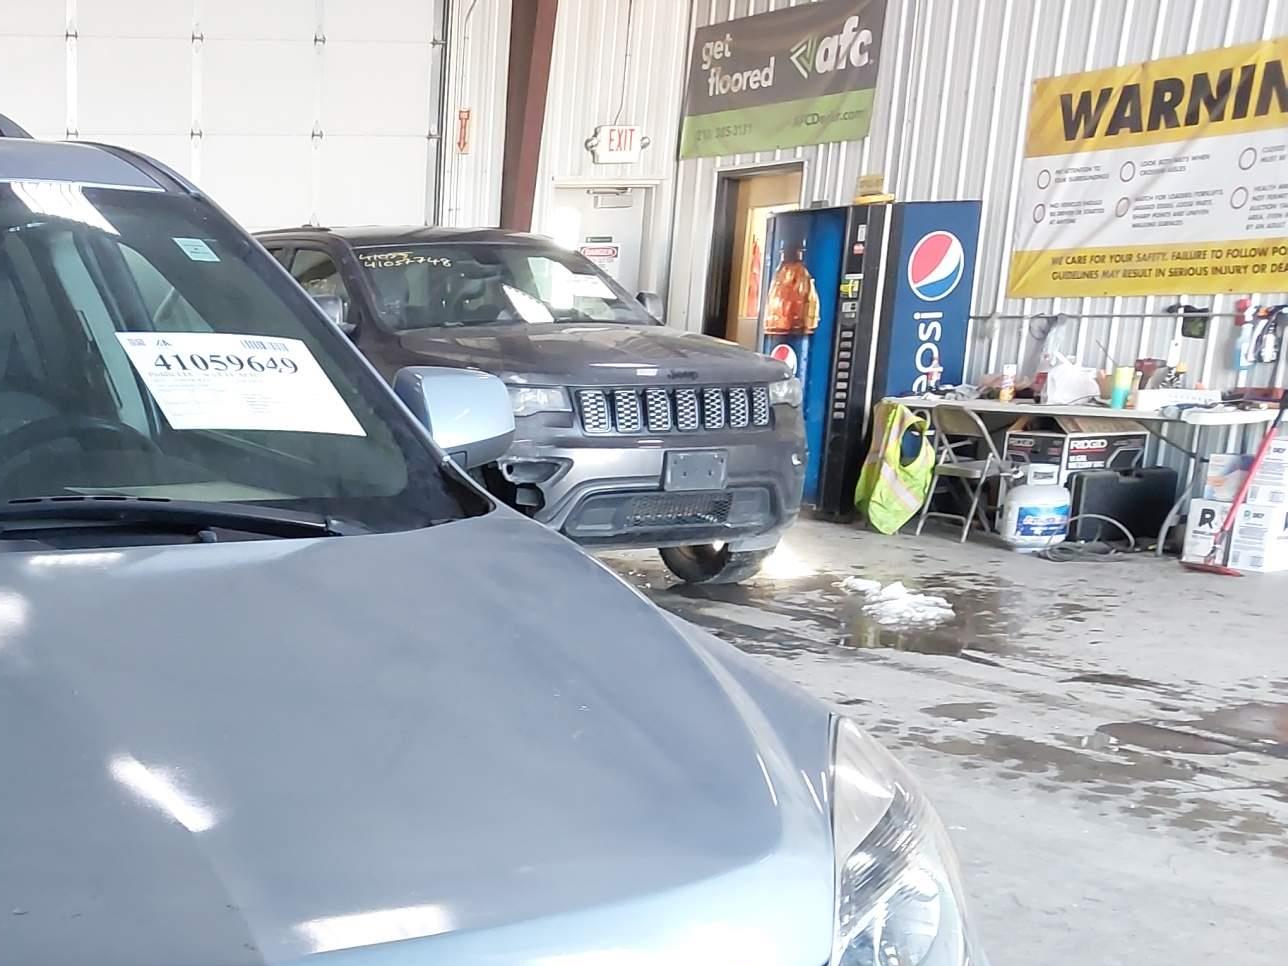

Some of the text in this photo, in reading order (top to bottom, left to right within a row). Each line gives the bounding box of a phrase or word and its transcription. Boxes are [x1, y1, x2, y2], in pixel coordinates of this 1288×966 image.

[702, 33, 732, 70] get
[815, 16, 872, 74] afc
[708, 56, 776, 97] floored
[1059, 60, 1288, 141] WARNIN
[608, 128, 636, 152] EXIT
[1065, 255, 1087, 265] CARE
[1089, 254, 1107, 264] FOR
[1109, 253, 1133, 263] YOUR
[1171, 250, 1209, 261] FAILURE
[1210, 249, 1223, 259] TO
[1225, 247, 1269, 258] FOLLOW
[1051, 269, 1099, 281] GUIDELINES
[1100, 269, 1120, 279] MAY
[1122, 267, 1153, 278] RESULT
[1155, 267, 1166, 277] IN
[1168, 266, 1209, 277] SERIOUS
[1211, 265, 1249, 275] INJURY
[1252, 263, 1268, 274] OR
[154, 353, 299, 375] 41059649
